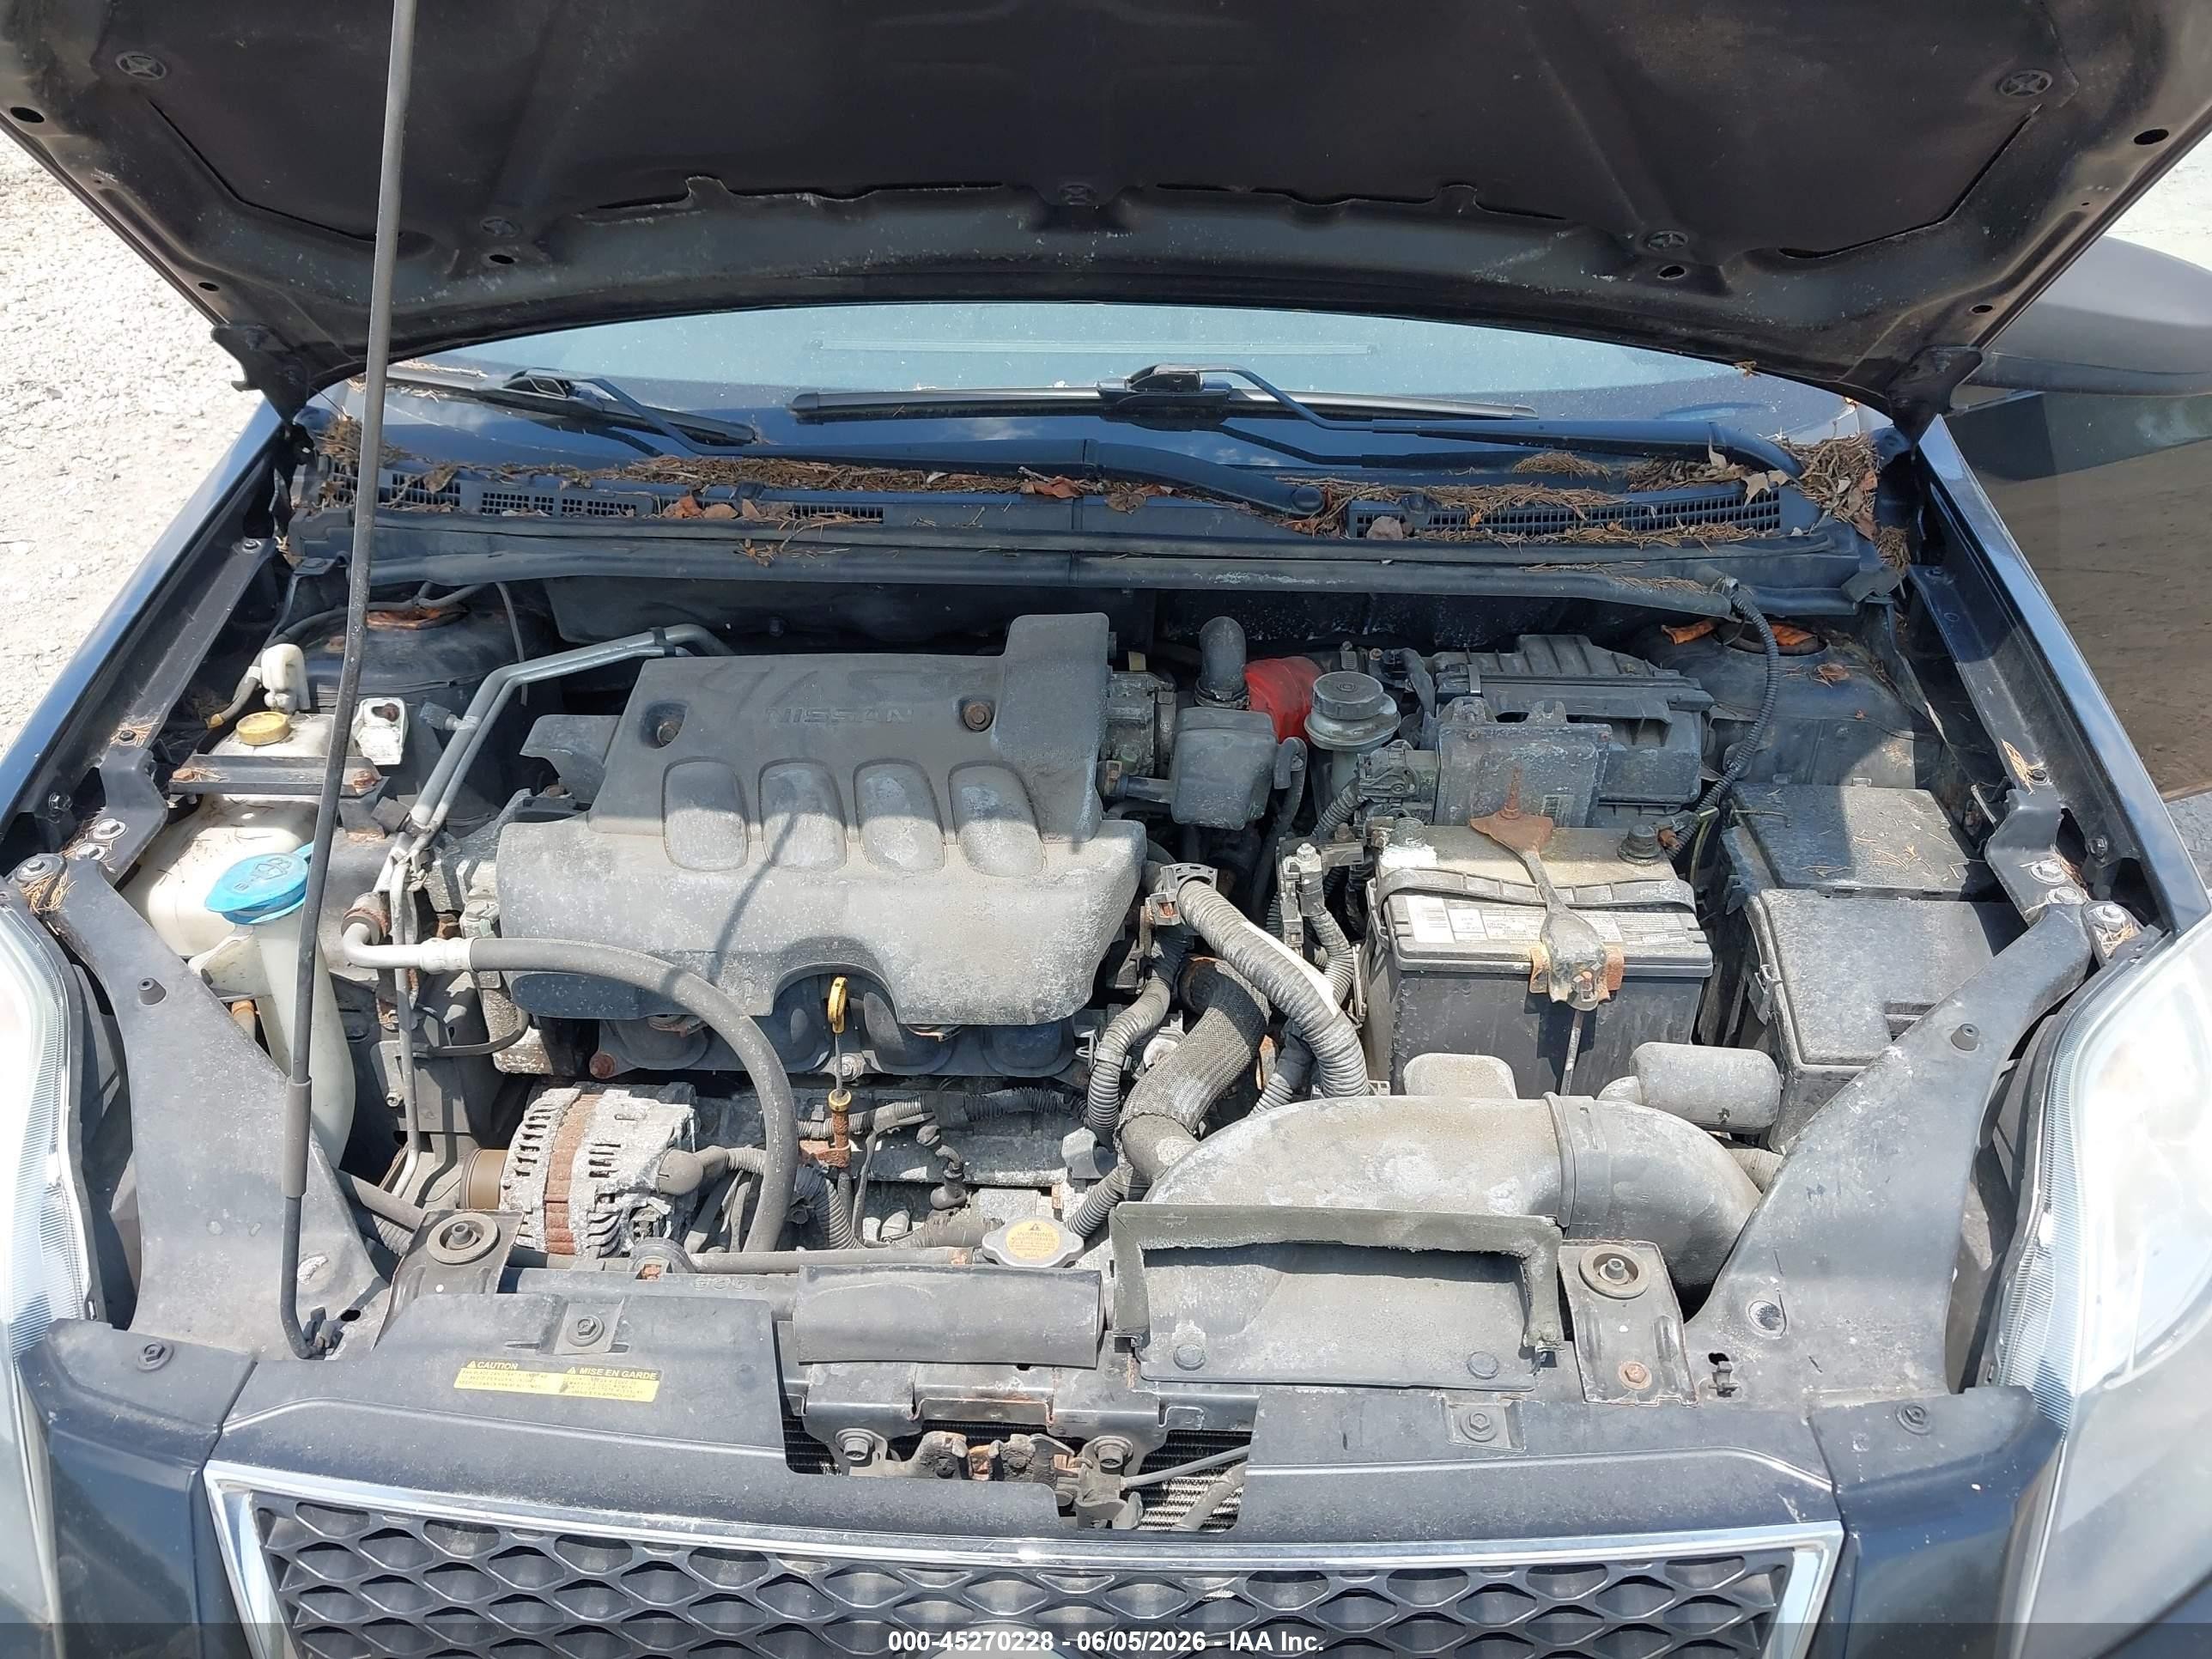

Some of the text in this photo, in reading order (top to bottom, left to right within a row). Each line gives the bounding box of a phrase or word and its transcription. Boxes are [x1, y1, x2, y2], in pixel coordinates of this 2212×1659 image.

[764, 707, 915, 724] NISSAN
[477, 1361, 520, 1370] CAUTION
[579, 1367, 659, 1380] MISE EN GARDE
